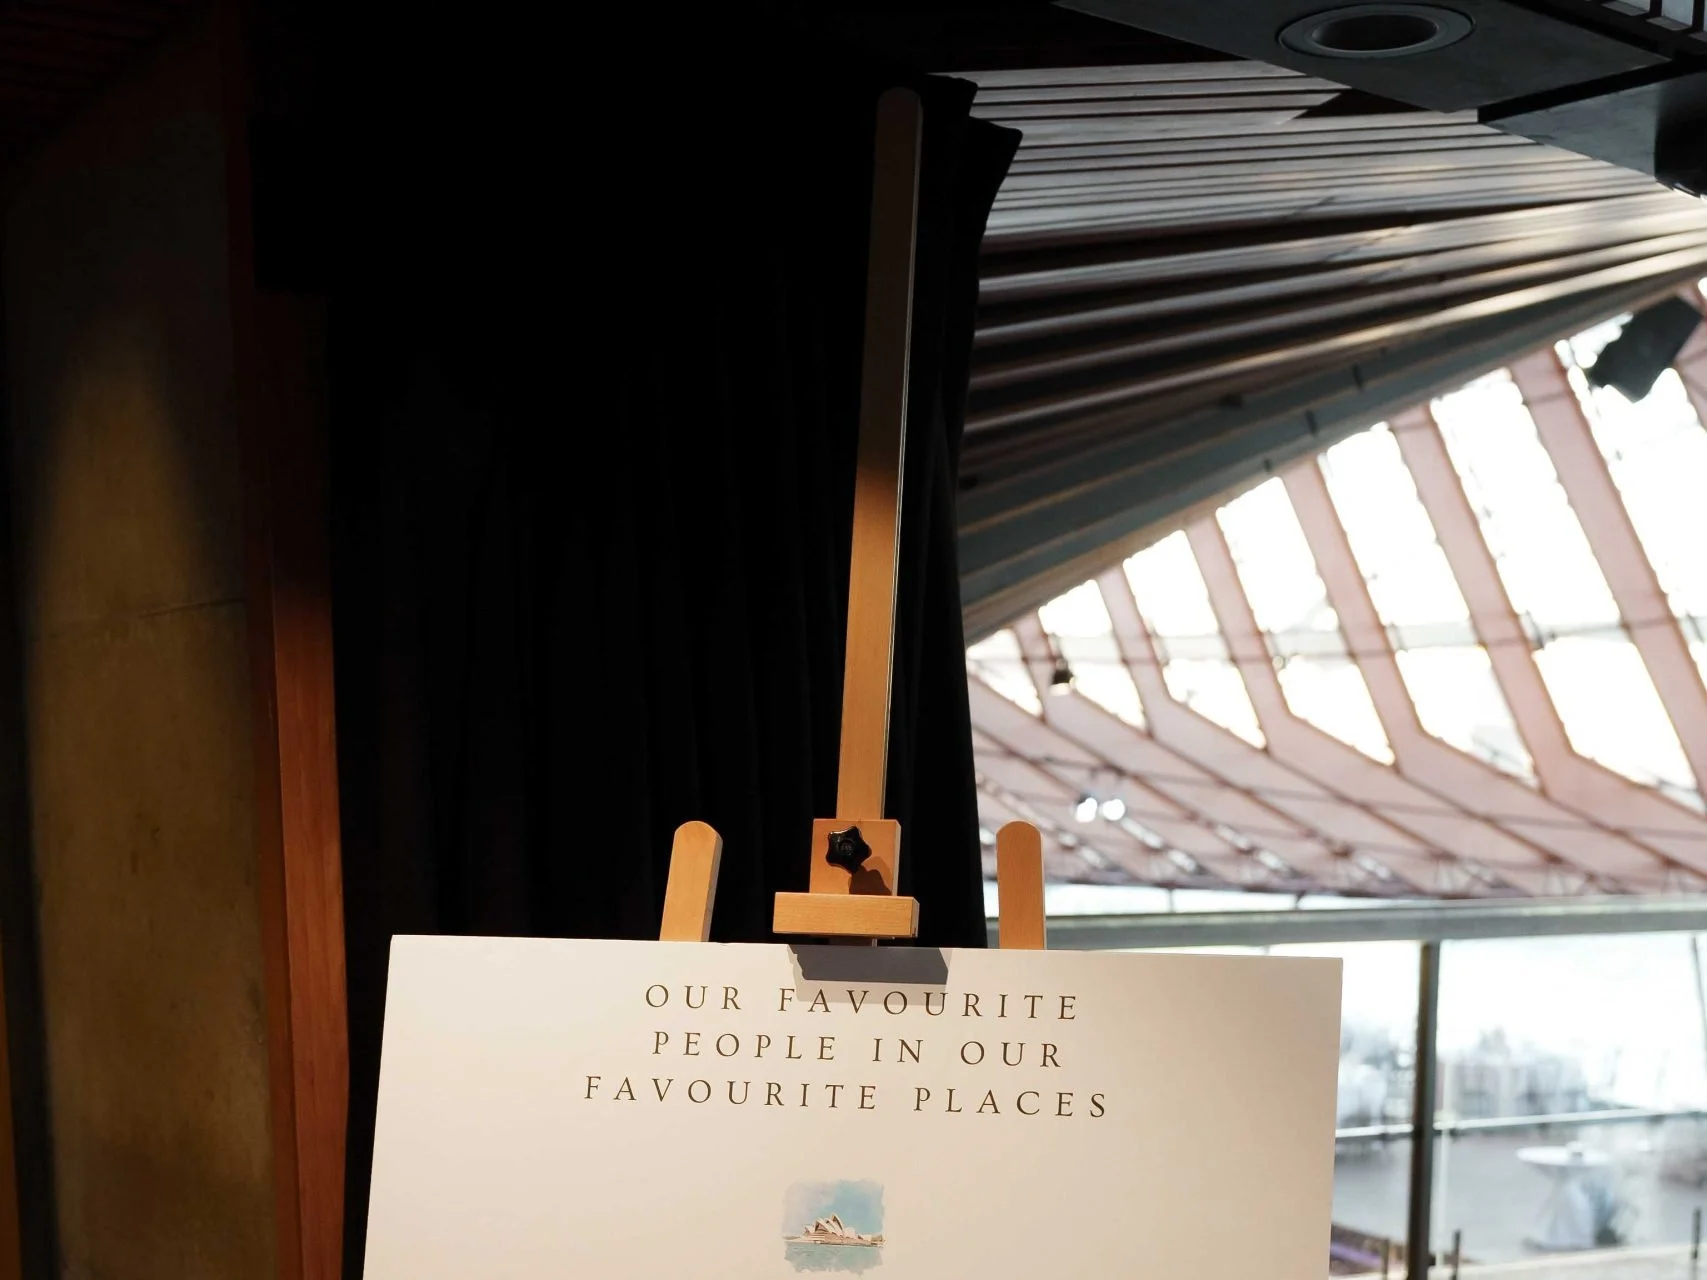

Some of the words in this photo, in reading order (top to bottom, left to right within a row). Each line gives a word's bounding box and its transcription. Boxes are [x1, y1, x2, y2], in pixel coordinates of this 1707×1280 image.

[645, 984, 742, 1010] OUR
[778, 988, 1078, 1020] FAVOURITE
[651, 1031, 837, 1061] PEOPLE
[872, 1038, 924, 1064] IN
[960, 1040, 1061, 1068] OUR
[583, 1076, 876, 1109] FAVOURITE
[913, 1087, 1106, 1119] PLACES
